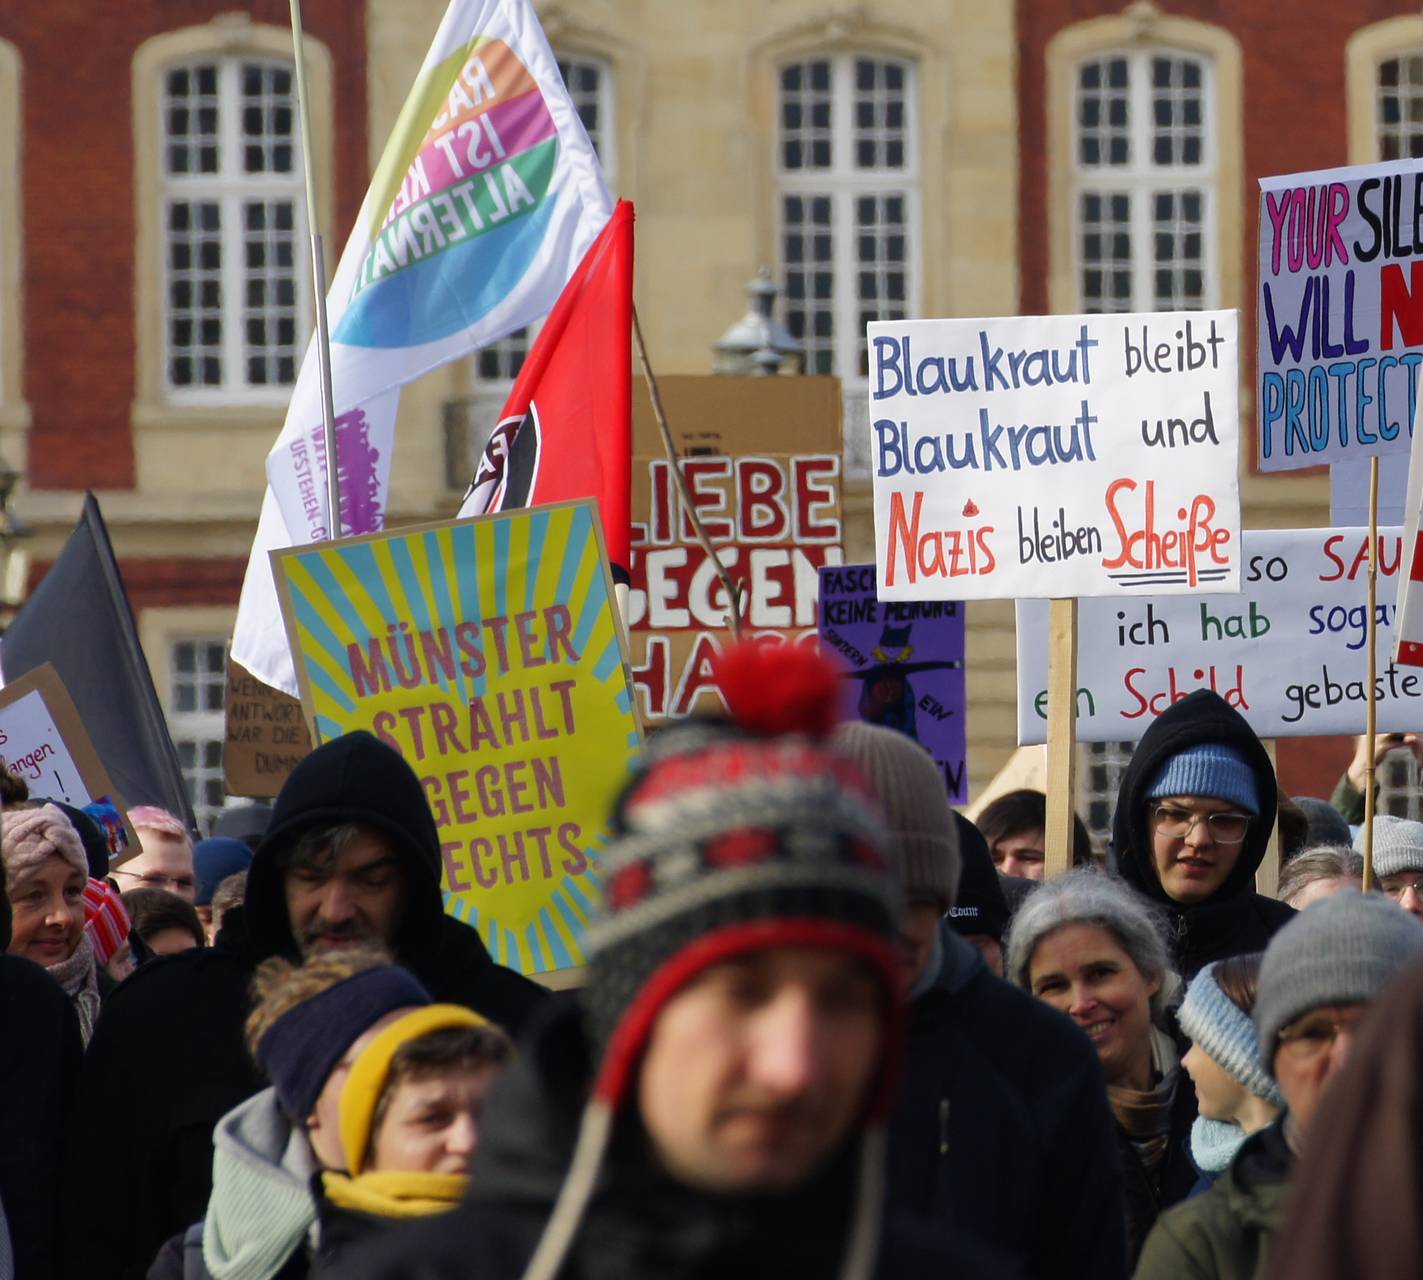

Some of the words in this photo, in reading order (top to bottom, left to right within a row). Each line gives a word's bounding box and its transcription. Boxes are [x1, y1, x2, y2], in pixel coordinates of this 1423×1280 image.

[1265, 182, 1350, 276] YOUR
[1263, 269, 1370, 366] WILL
[872, 325, 1099, 401] Blaukraut
[1124, 320, 1225, 377] bleibt
[873, 400, 1098, 477] Blaukraut
[1141, 391, 1220, 448] und
[631, 454, 843, 546] IEBE
[885, 491, 995, 588] Nazis
[1017, 505, 1102, 564] bleiben
[1102, 478, 1231, 588] Scheiße
[1246, 554, 1288, 583] so
[346, 603, 582, 699] MÜNSTER
[824, 597, 879, 627] KEINE
[1117, 604, 1170, 647] ich
[1200, 602, 1271, 641] hab
[1308, 604, 1397, 651] soga
[272, 725, 301, 745] DIE
[372, 679, 577, 762] STRAHLT
[918, 694, 955, 722] EIN
[421, 755, 566, 829] GEGEN
[441, 821, 601, 893] ECHTS.
